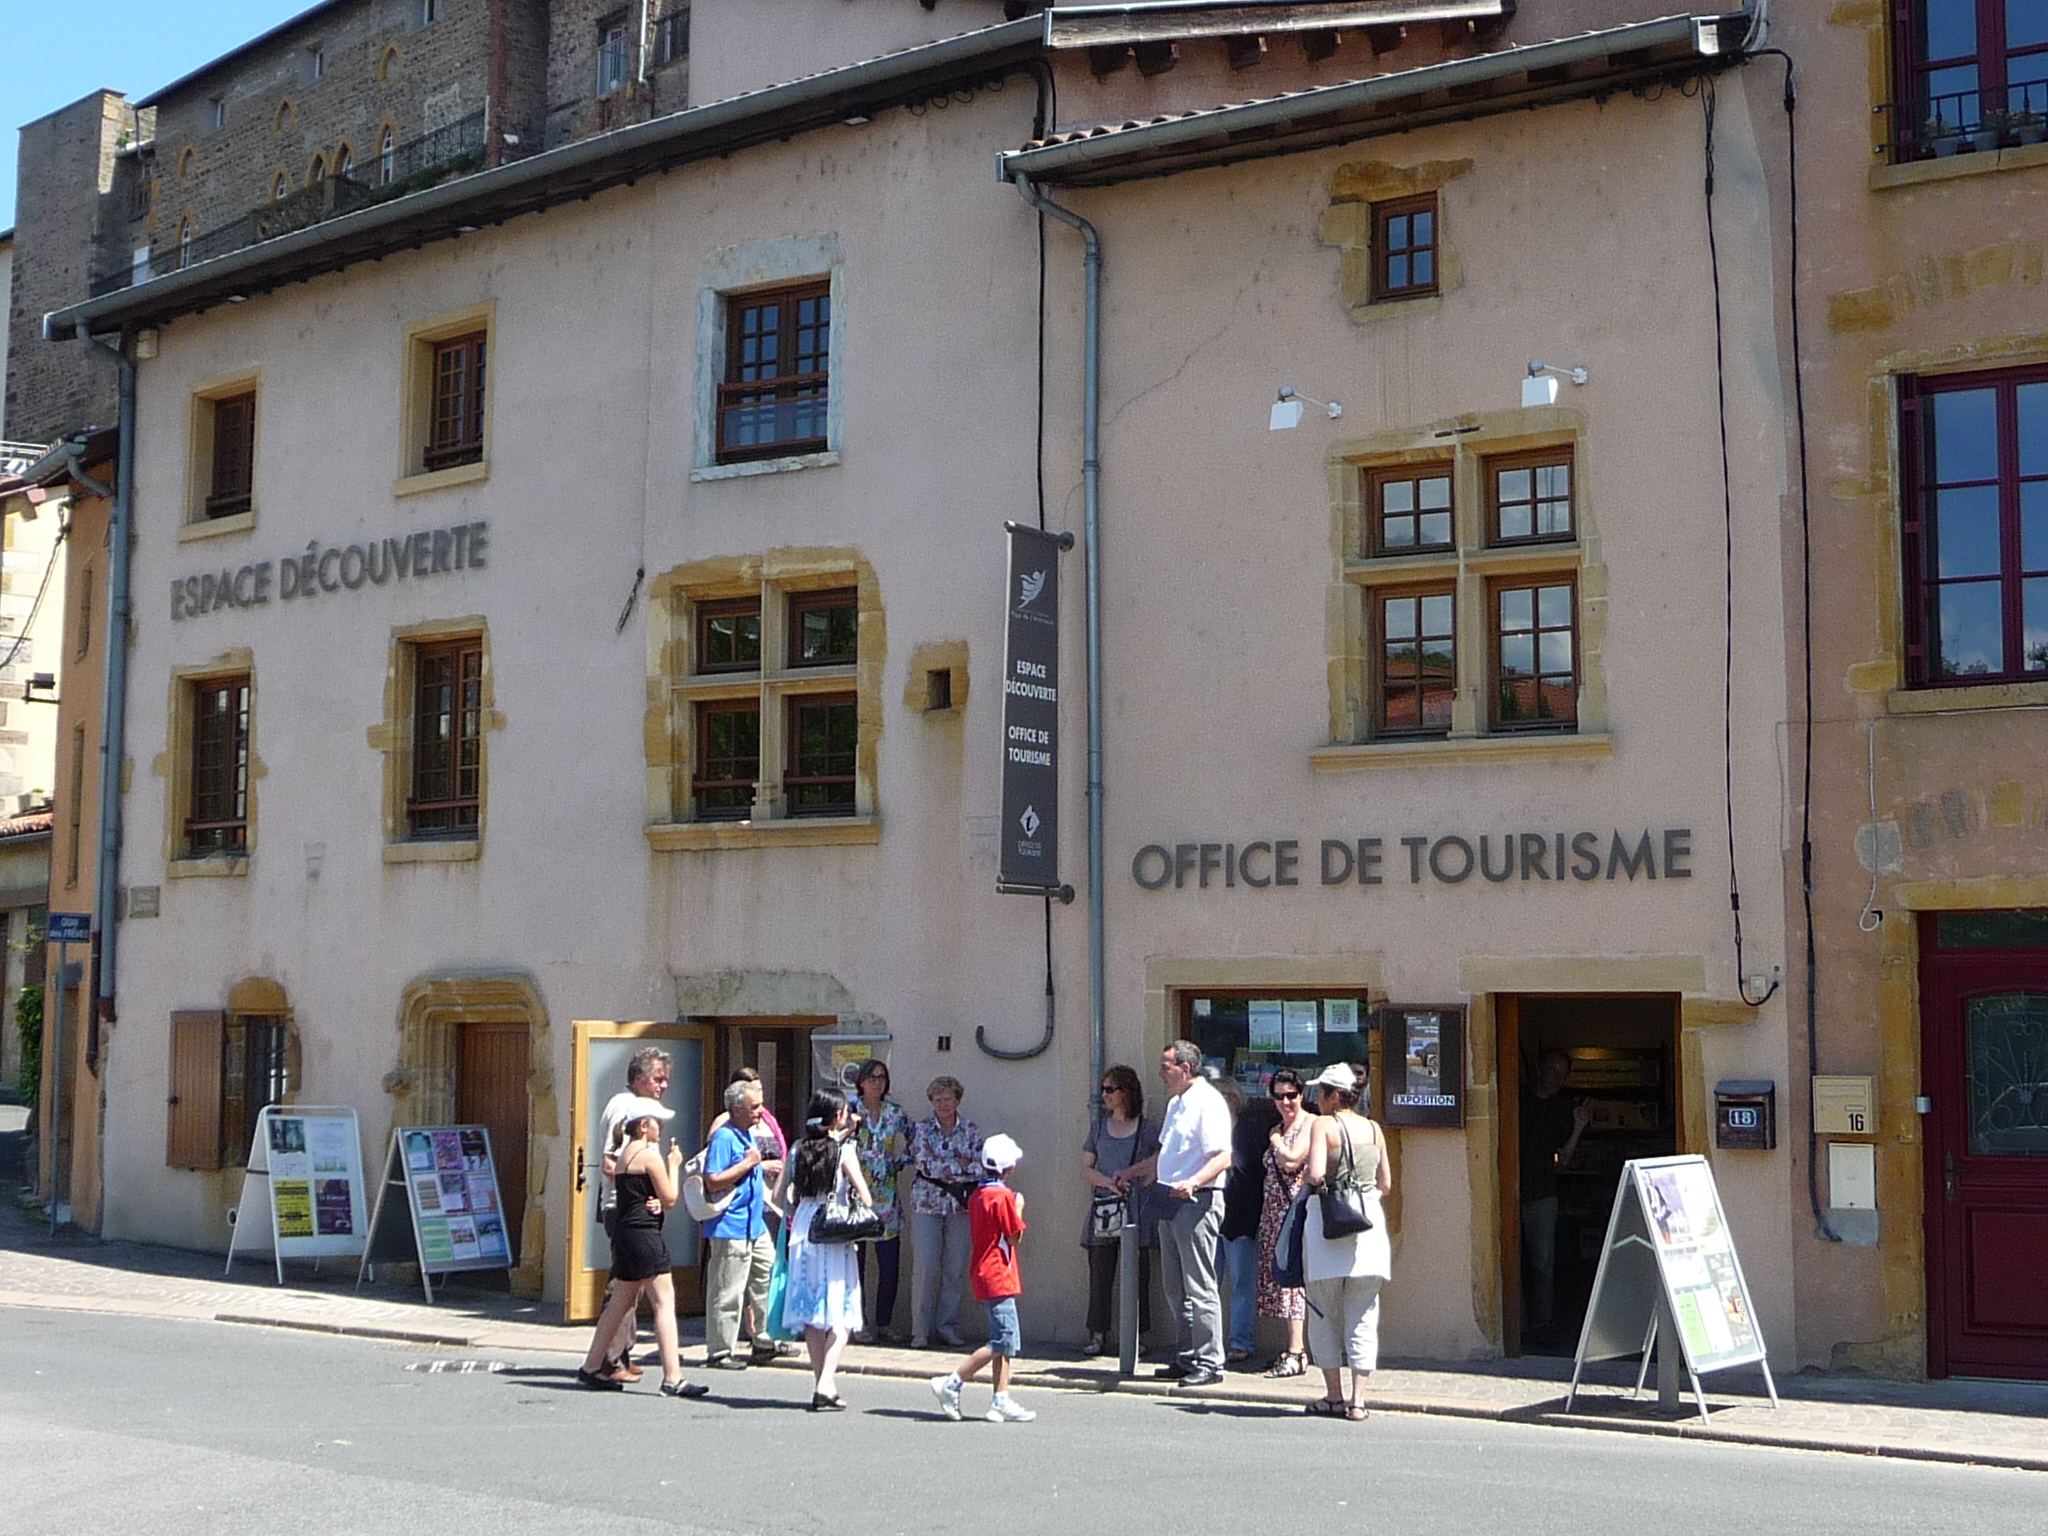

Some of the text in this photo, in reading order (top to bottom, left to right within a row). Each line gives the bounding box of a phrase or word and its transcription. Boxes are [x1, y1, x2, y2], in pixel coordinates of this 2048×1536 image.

[170, 520, 488, 621] ESPACE DÉCOUVERTE
[1016, 660, 1047, 679] ESPACE
[1005, 676, 1057, 702] DÉCOUVERTE
[1008, 725, 1050, 744] OFFICE DE
[1008, 747, 1051, 766] TOURISME
[1131, 828, 1692, 890] OFFICE DE TOURISME
[1394, 1095, 1454, 1105] EXPOSITION
[1732, 1110, 1751, 1125] 18
[1848, 1113, 1865, 1132] 16
